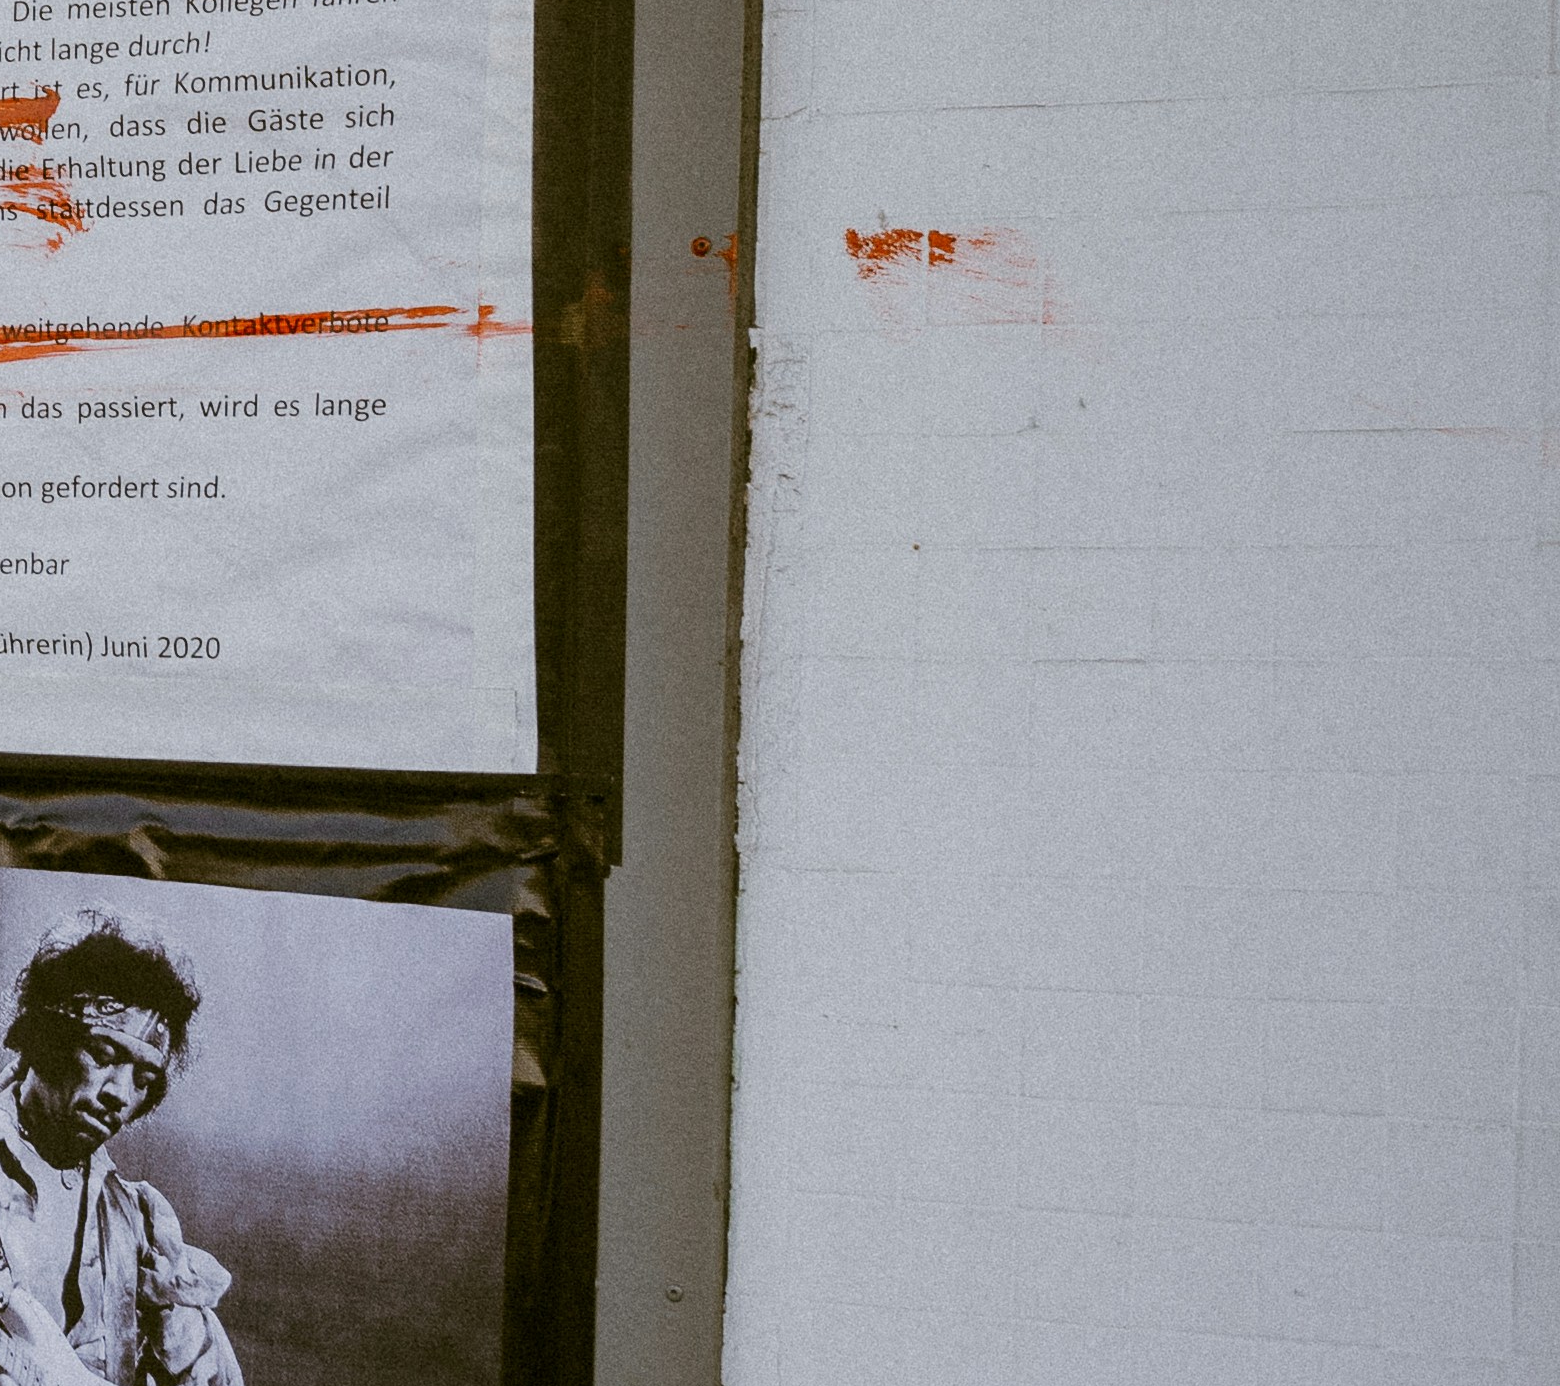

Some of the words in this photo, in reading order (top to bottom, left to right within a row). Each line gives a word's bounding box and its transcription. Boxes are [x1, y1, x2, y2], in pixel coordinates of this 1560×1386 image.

[40, 474, 160, 505] gefordert
[166, 474, 226, 500] sind.
[100, 635, 148, 659] Juni
[157, 635, 221, 660] 2020
